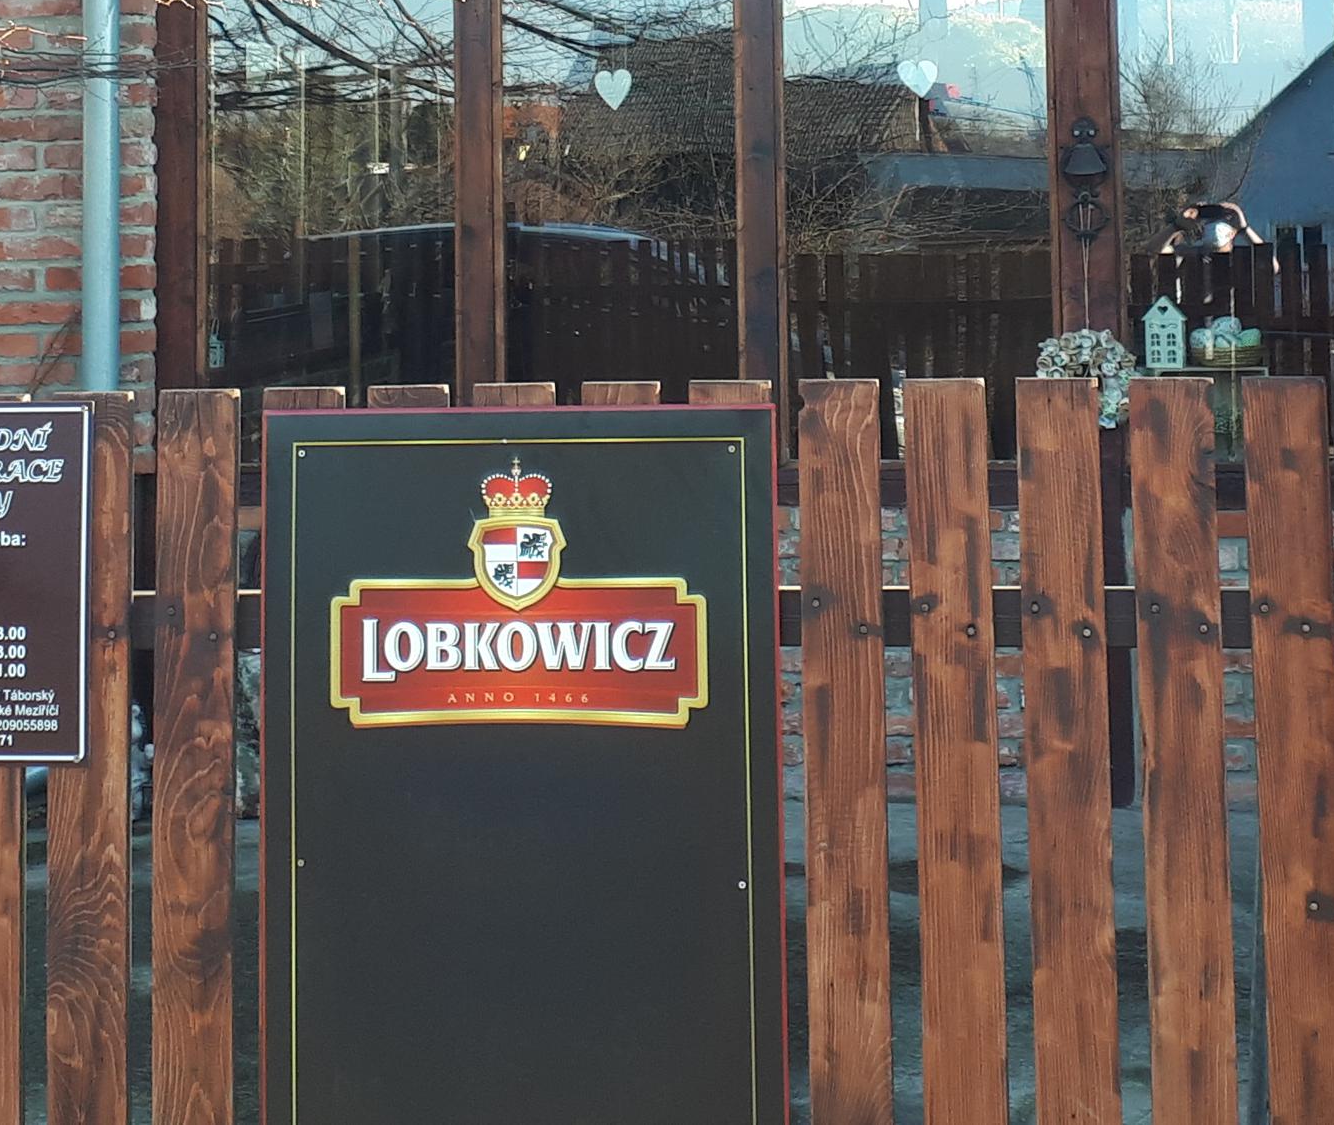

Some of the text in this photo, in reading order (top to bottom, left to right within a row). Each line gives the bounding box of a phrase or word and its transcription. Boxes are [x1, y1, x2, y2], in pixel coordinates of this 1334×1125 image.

[361, 618, 676, 682] LOBKOWICZ
[3, 689, 55, 704] Táborský
[448, 693, 590, 704] ANNO 1466
[0, 734, 12, 746] 71
